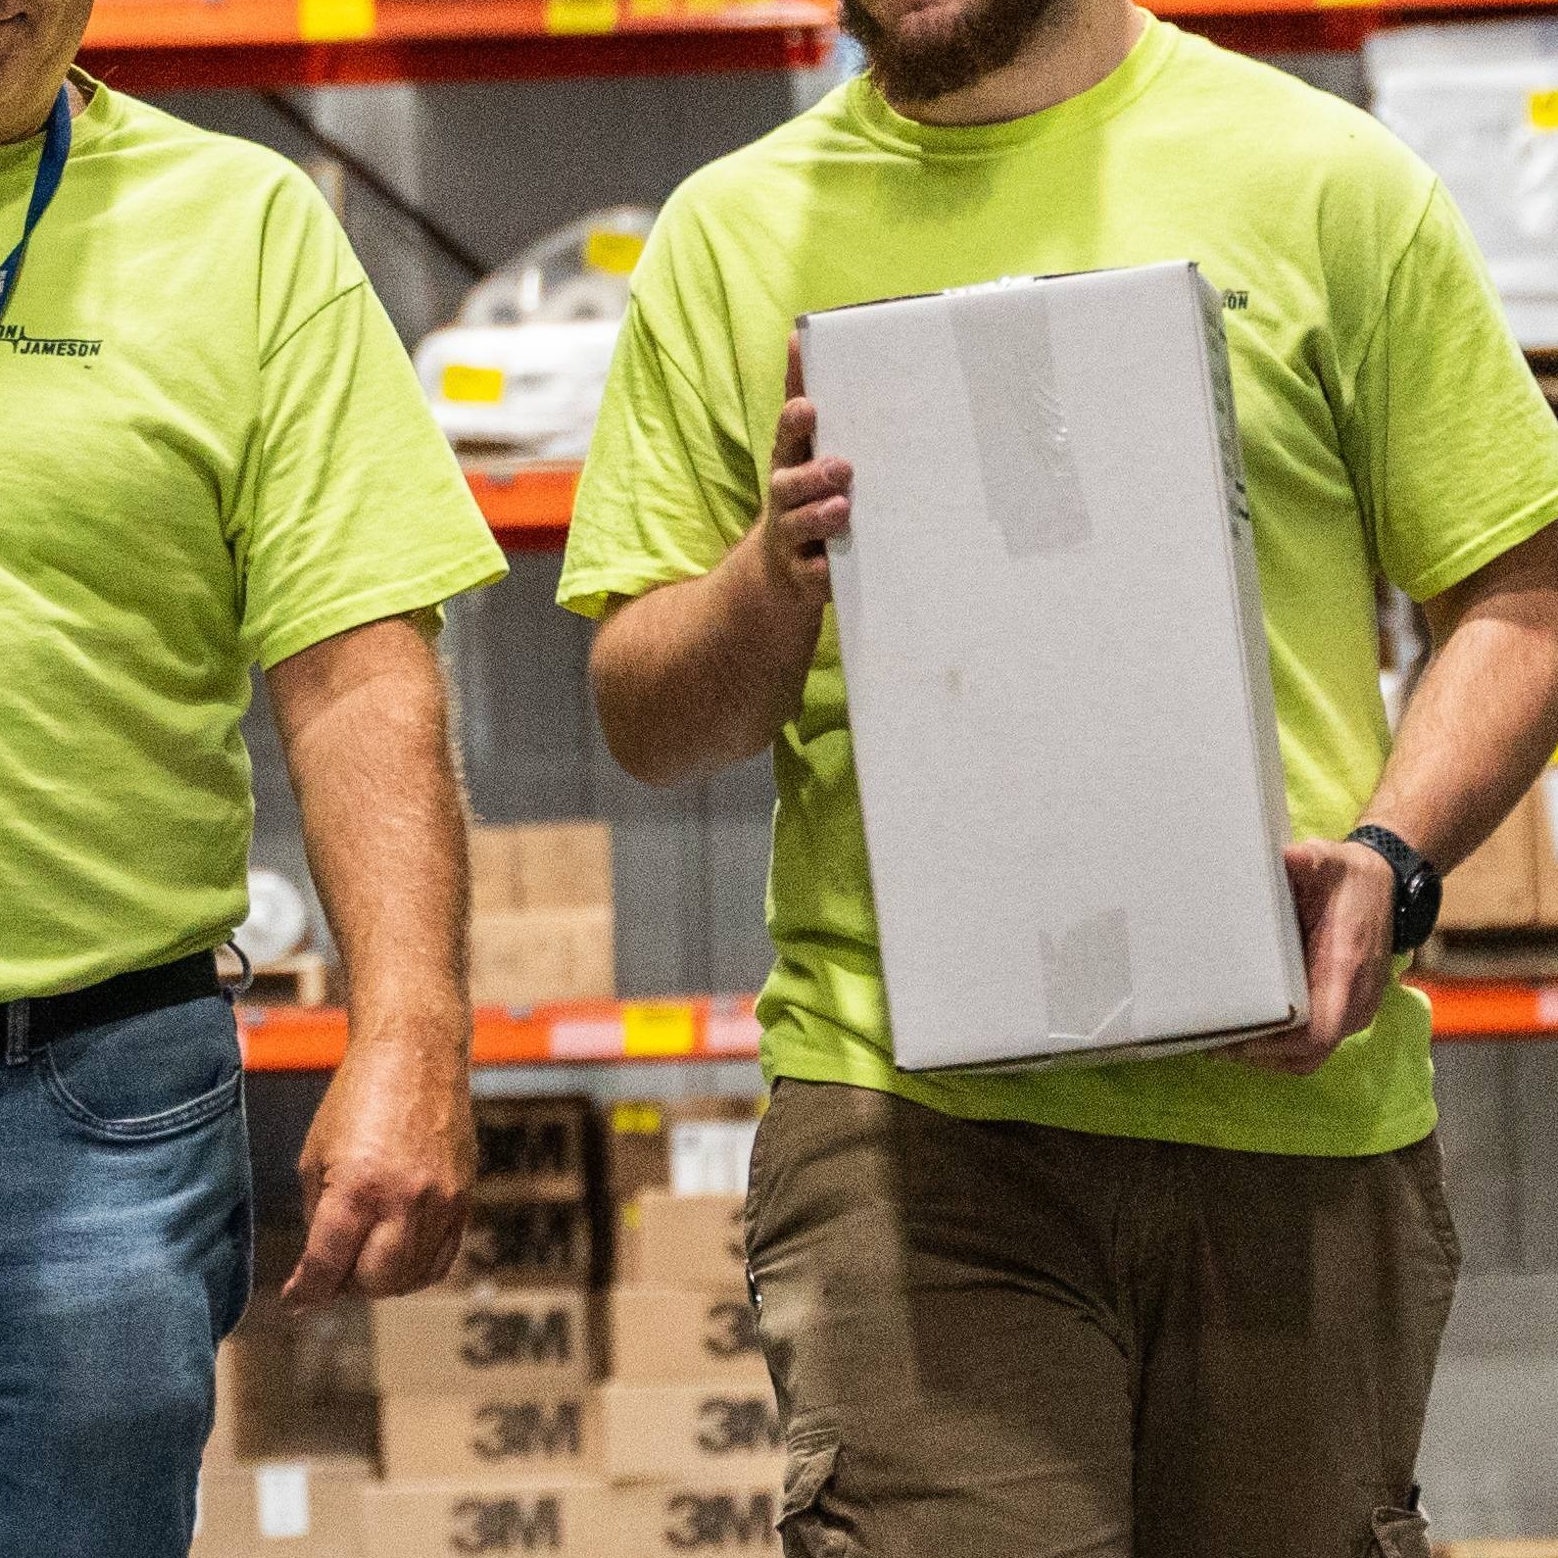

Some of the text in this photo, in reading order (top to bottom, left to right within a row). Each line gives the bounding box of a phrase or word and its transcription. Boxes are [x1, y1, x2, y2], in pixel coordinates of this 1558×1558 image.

[20, 341, 102, 357] JAMESON
[462, 1309, 572, 1366] 3M
[472, 1400, 581, 1461] 3M
[447, 1496, 561, 1556] 3M
[664, 1493, 776, 1550] 3M
